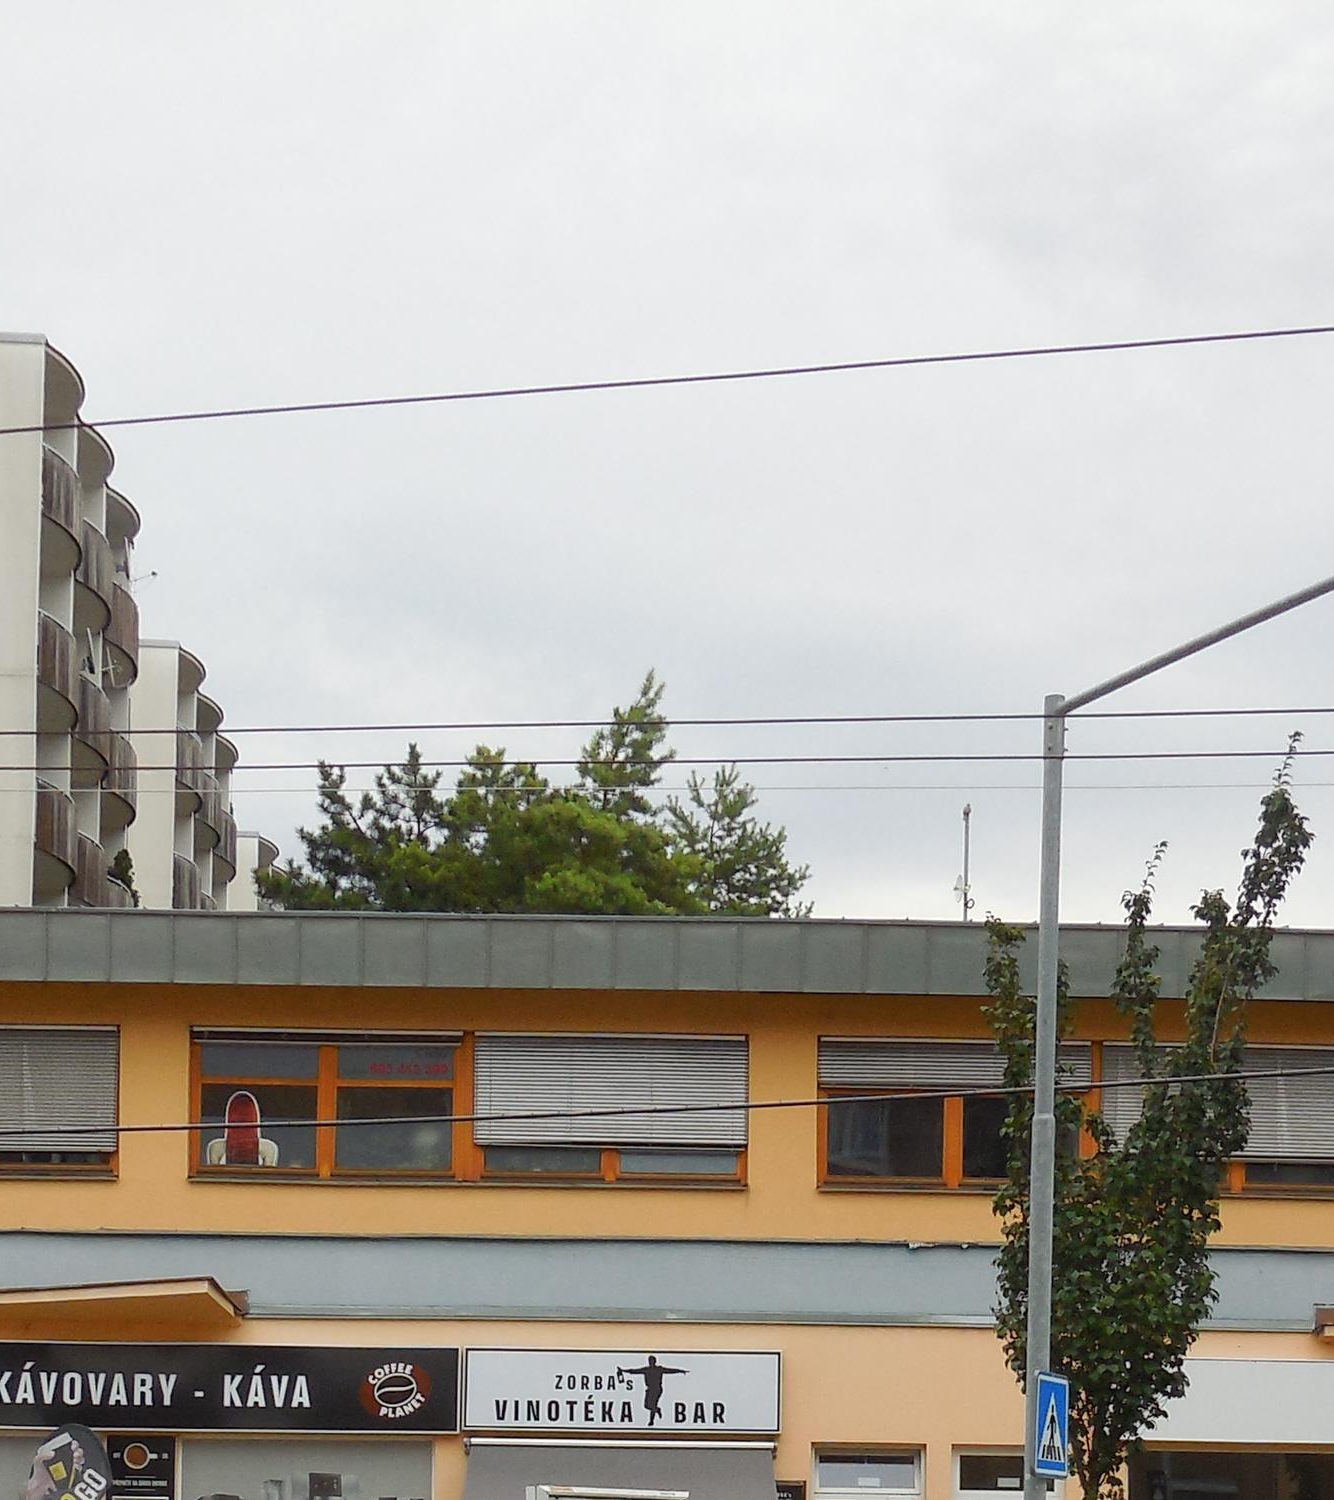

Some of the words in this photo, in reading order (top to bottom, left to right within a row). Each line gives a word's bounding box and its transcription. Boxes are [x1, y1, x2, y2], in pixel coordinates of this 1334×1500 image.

[223, 1364, 311, 1408] KÁVA
[368, 1362, 413, 1384] COFFEE
[379, 1393, 426, 1418] PLANET
[495, 1395, 634, 1423] VINOTÉKA
[674, 1402, 726, 1424] BAR
